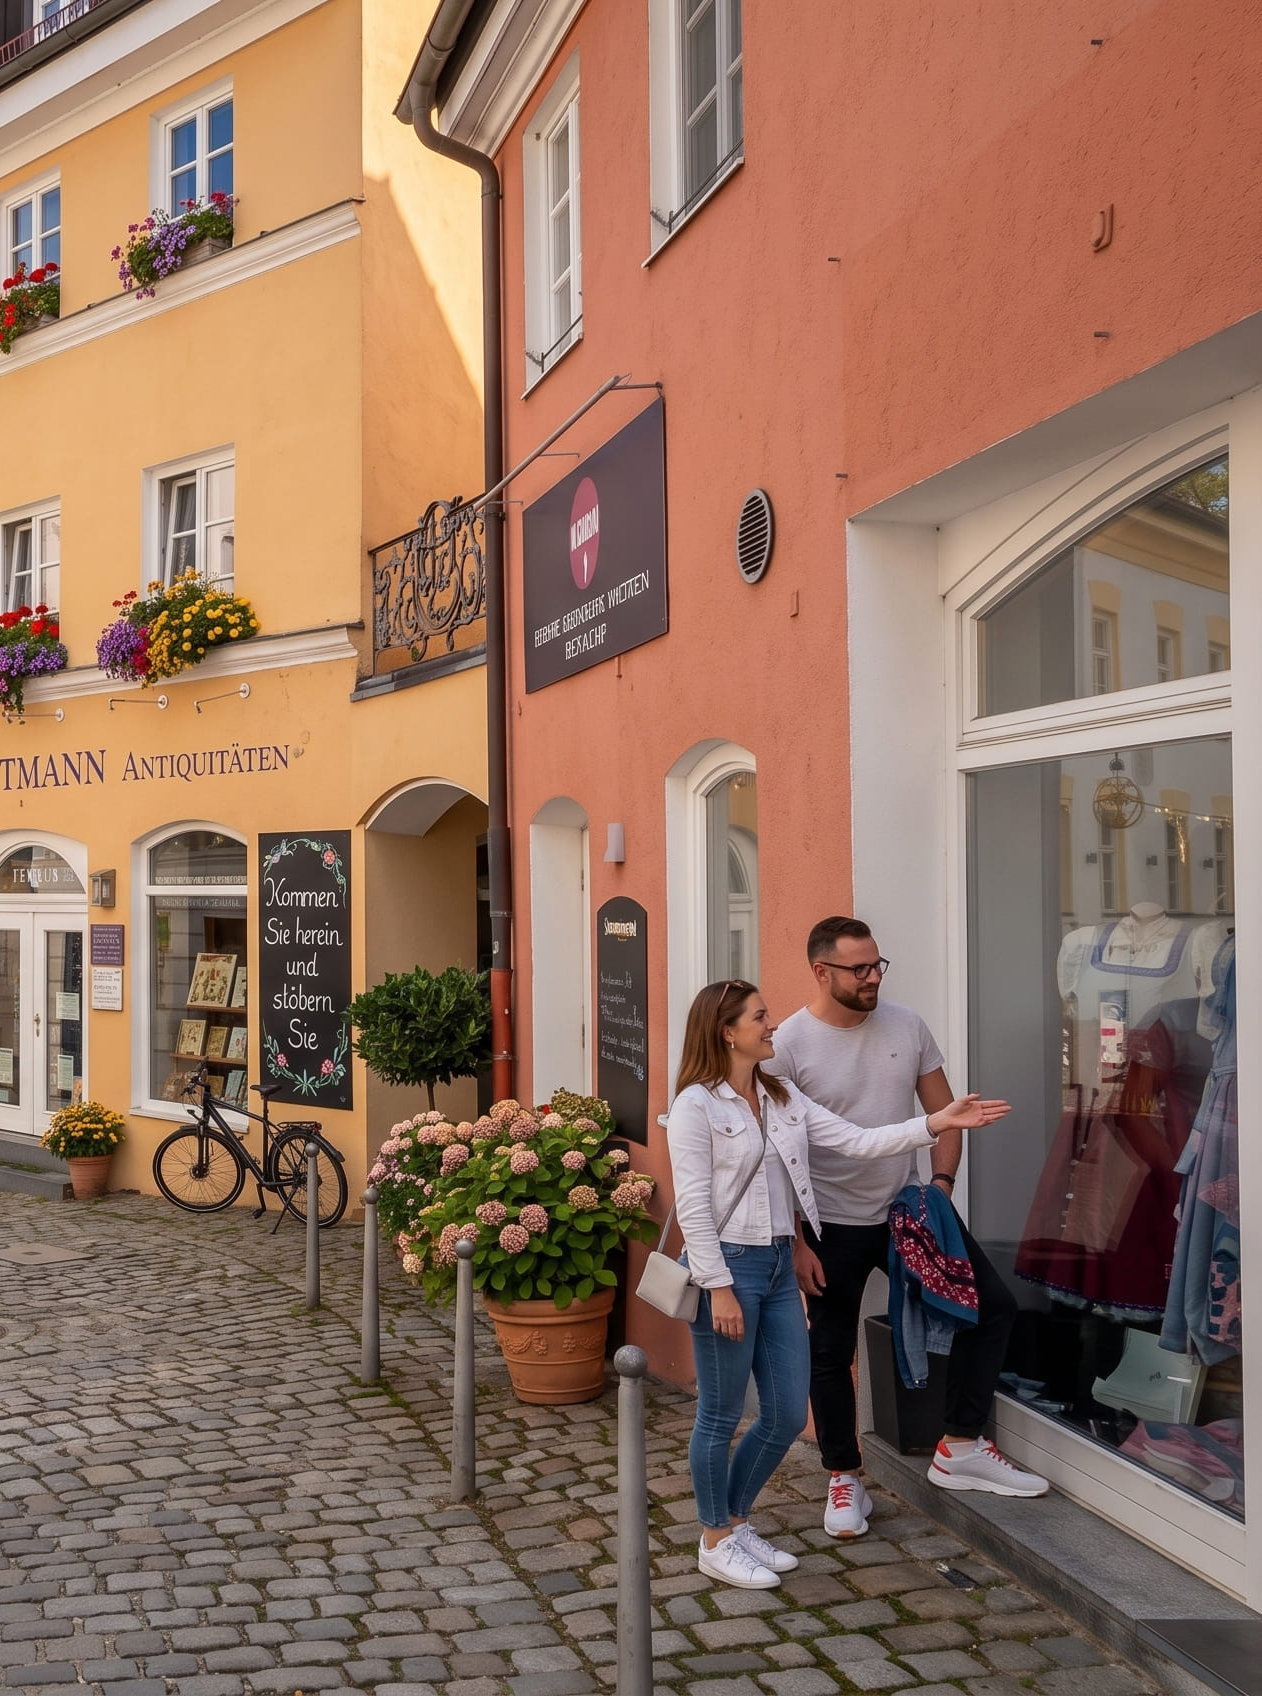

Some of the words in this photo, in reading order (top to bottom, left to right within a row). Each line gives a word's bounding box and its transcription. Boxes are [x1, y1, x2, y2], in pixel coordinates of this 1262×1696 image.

[122, 742, 290, 782] ANTIQUITÄTEN
[264, 877, 339, 907] Kommen
[264, 917, 291, 945] Sie
[295, 916, 344, 946] herein
[286, 952, 319, 977] und
[272, 983, 335, 1013] stöbern
[288, 1018, 319, 1050] Sie
